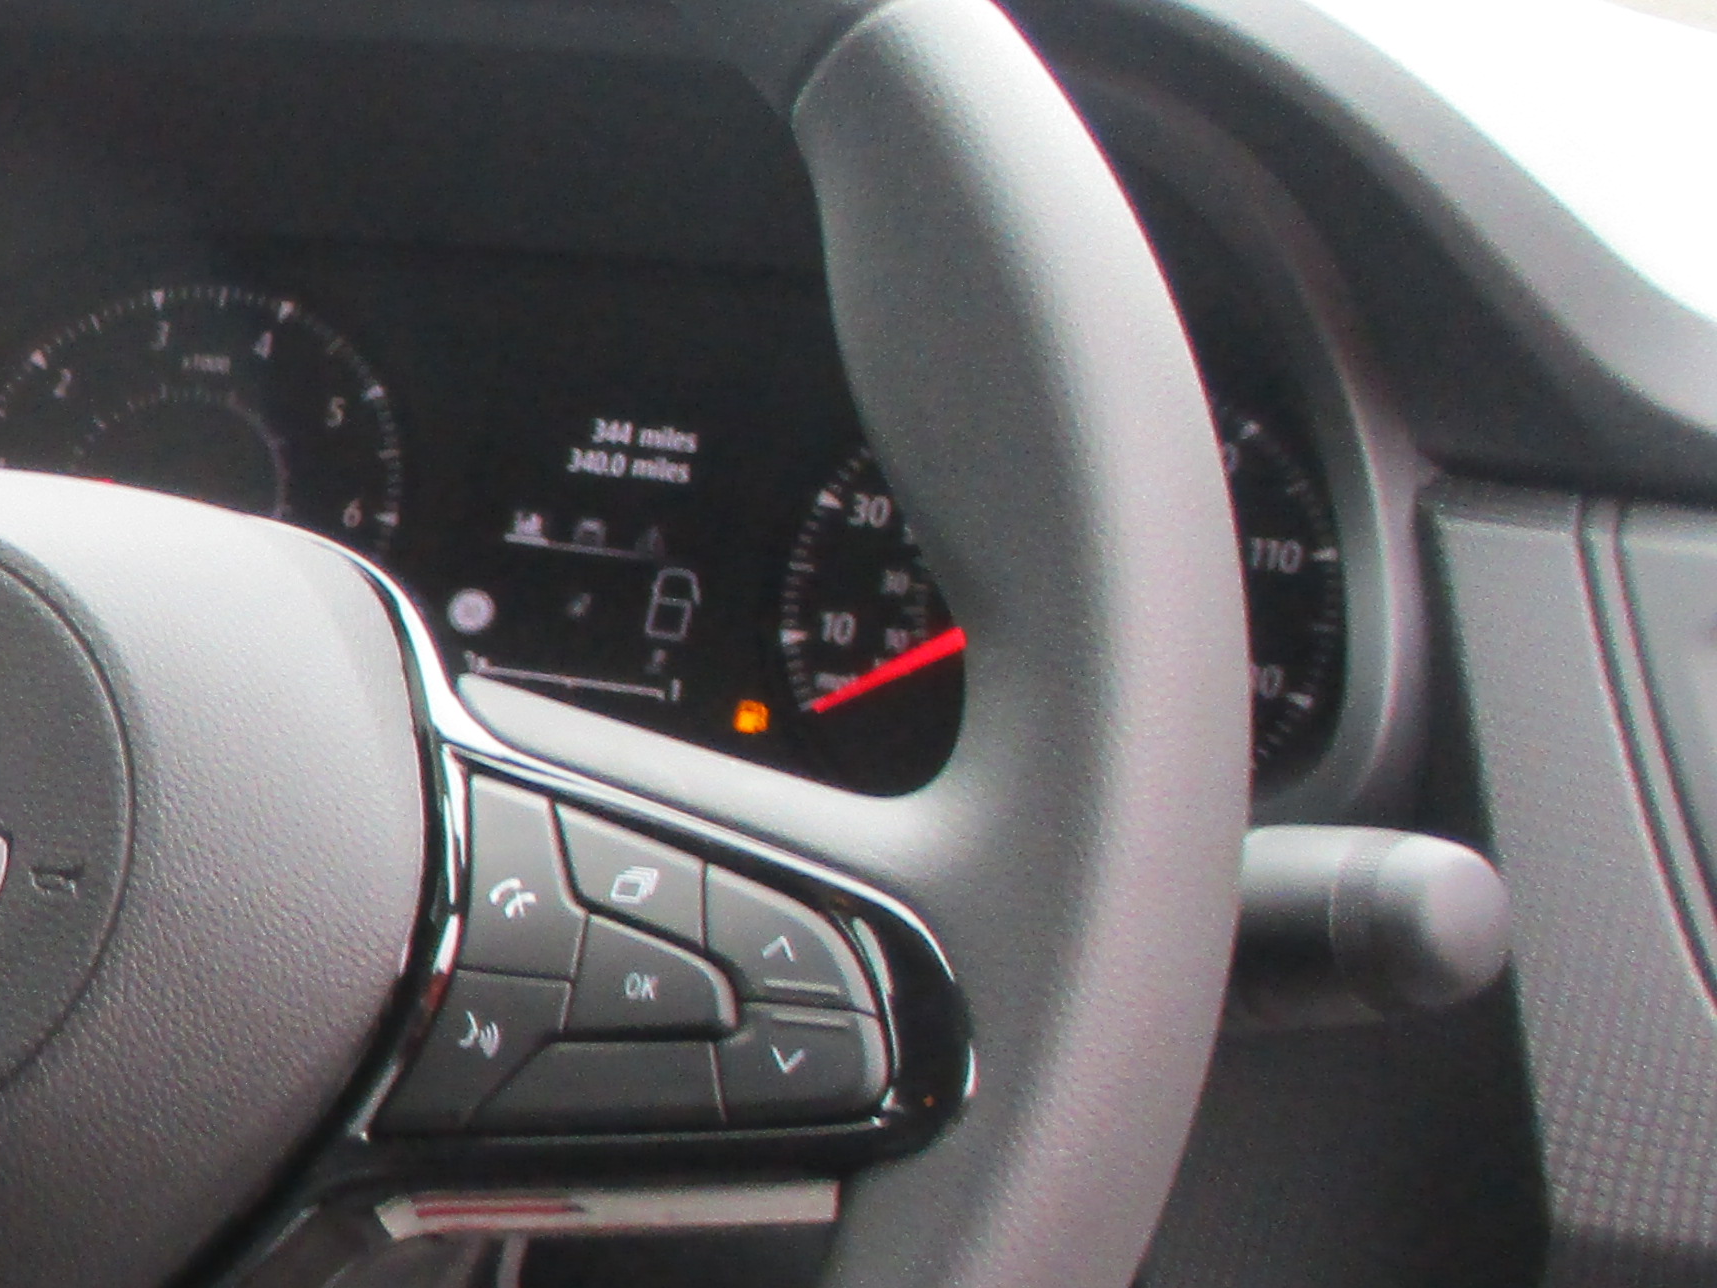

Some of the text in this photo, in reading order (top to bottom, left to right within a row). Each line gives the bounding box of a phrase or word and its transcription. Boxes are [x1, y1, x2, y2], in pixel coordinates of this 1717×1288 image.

[326, 396, 346, 428] 5
[591, 417, 699, 453] 344 miles
[566, 447, 691, 484] 340.0 miles
[342, 498, 363, 529] 6
[848, 492, 892, 529] 30
[1250, 537, 1303, 574] 110
[821, 611, 857, 646] 10
[624, 971, 659, 1001] OK
